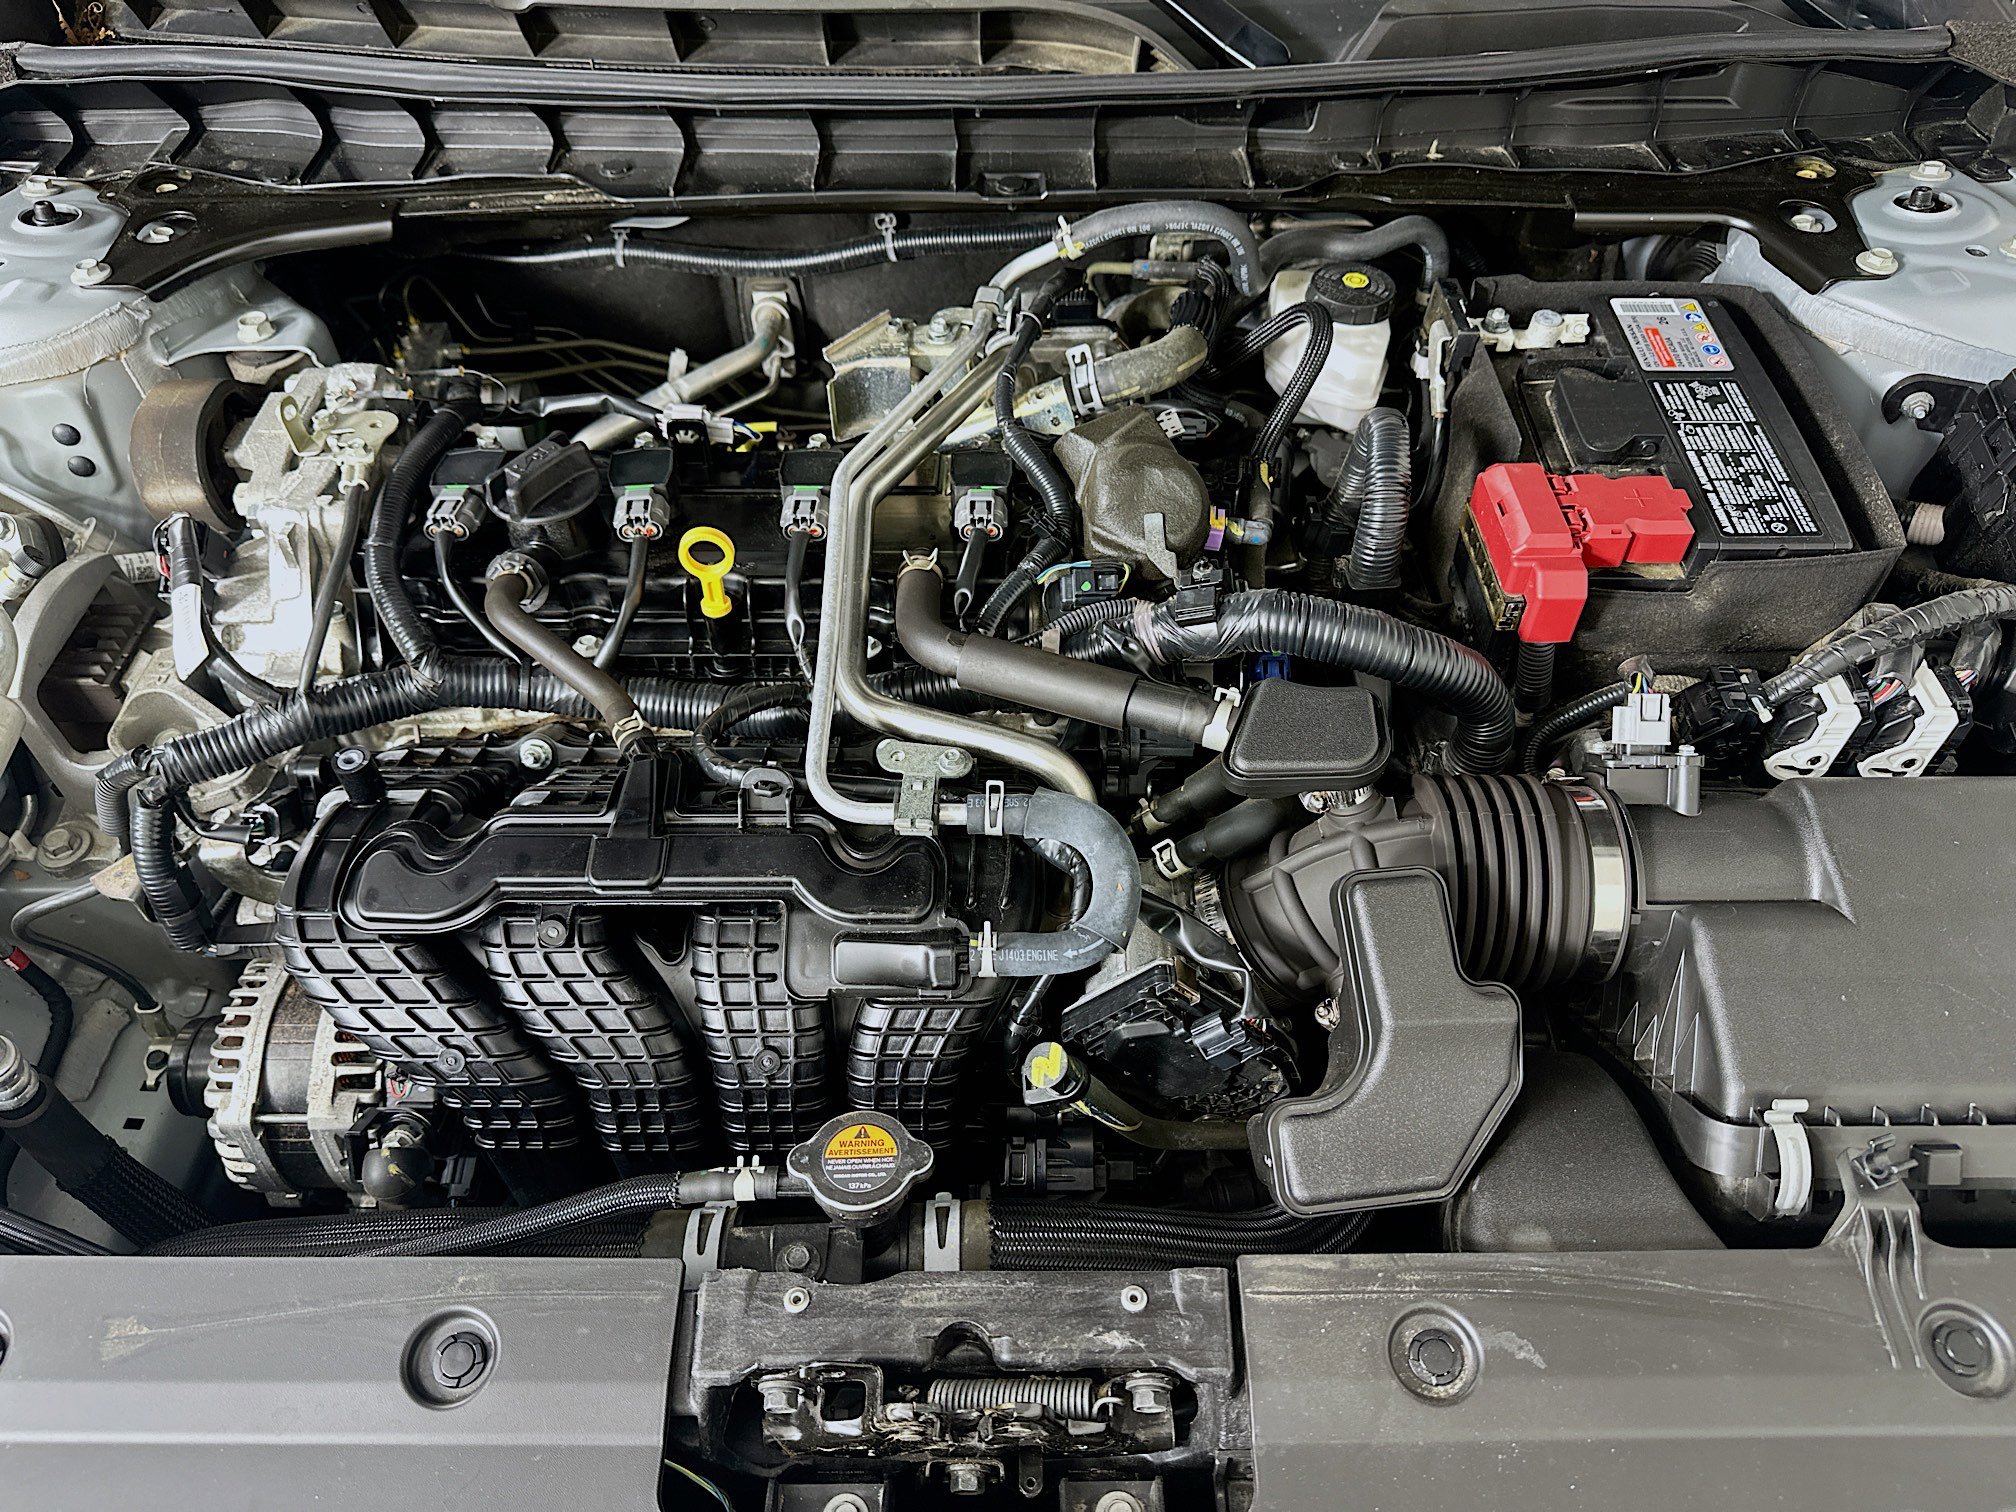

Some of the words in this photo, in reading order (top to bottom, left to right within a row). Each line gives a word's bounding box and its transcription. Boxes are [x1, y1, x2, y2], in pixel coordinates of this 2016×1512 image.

[999, 949, 1025, 961] J1403
[1027, 949, 1058, 961] ENGINE
[839, 1139, 884, 1148] WARNING
[828, 1148, 894, 1156] AVERTISSEMENT
